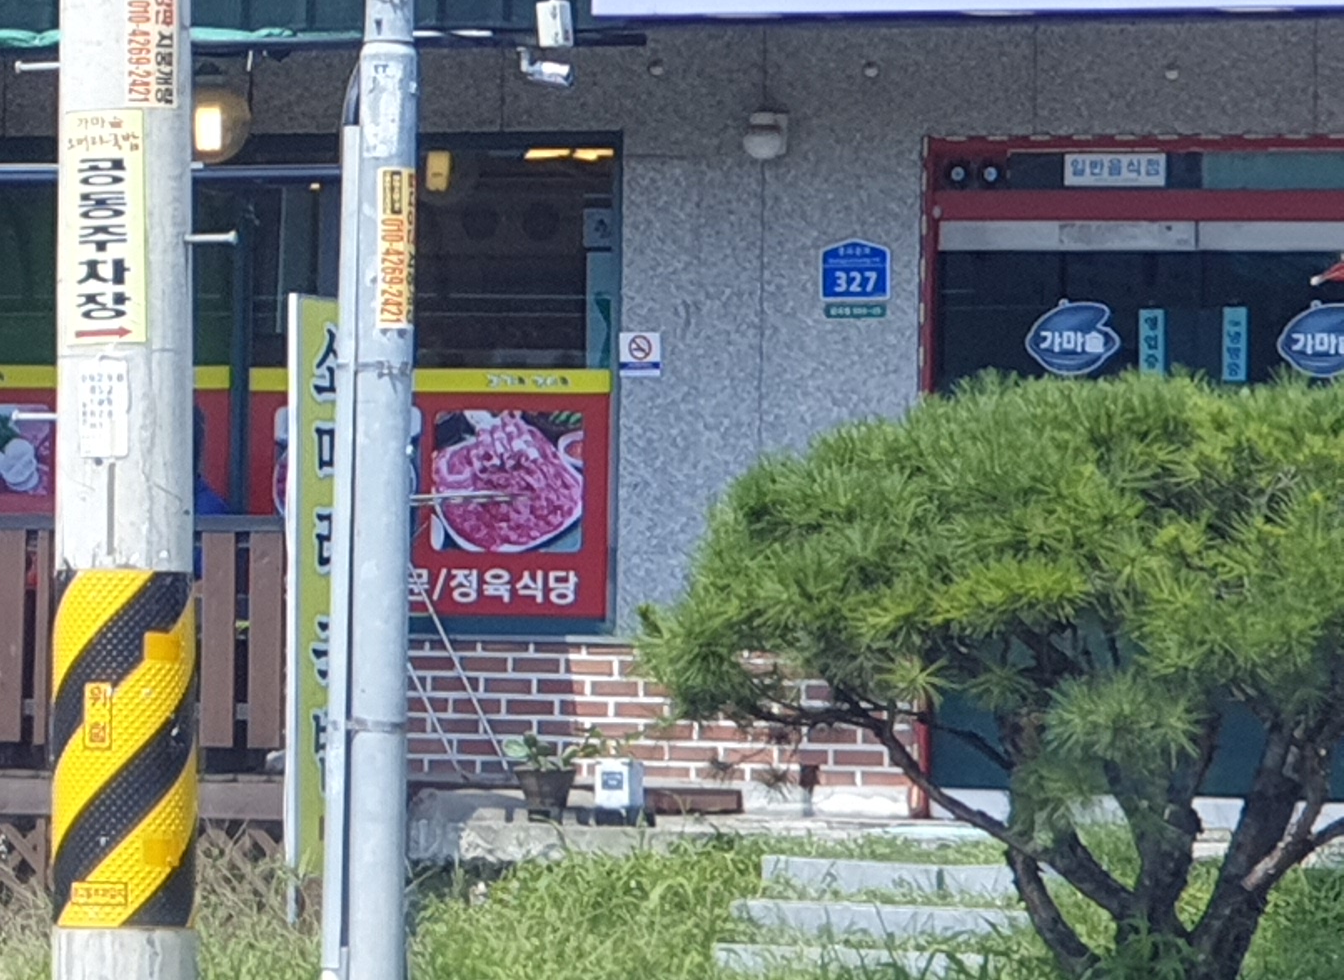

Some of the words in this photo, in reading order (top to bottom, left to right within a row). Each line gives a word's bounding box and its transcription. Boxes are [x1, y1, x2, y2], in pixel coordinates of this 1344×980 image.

[1070, 158, 1160, 177] 일반음식점
[76, 157, 132, 320] 공동주차장
[833, 270, 878, 293] 327
